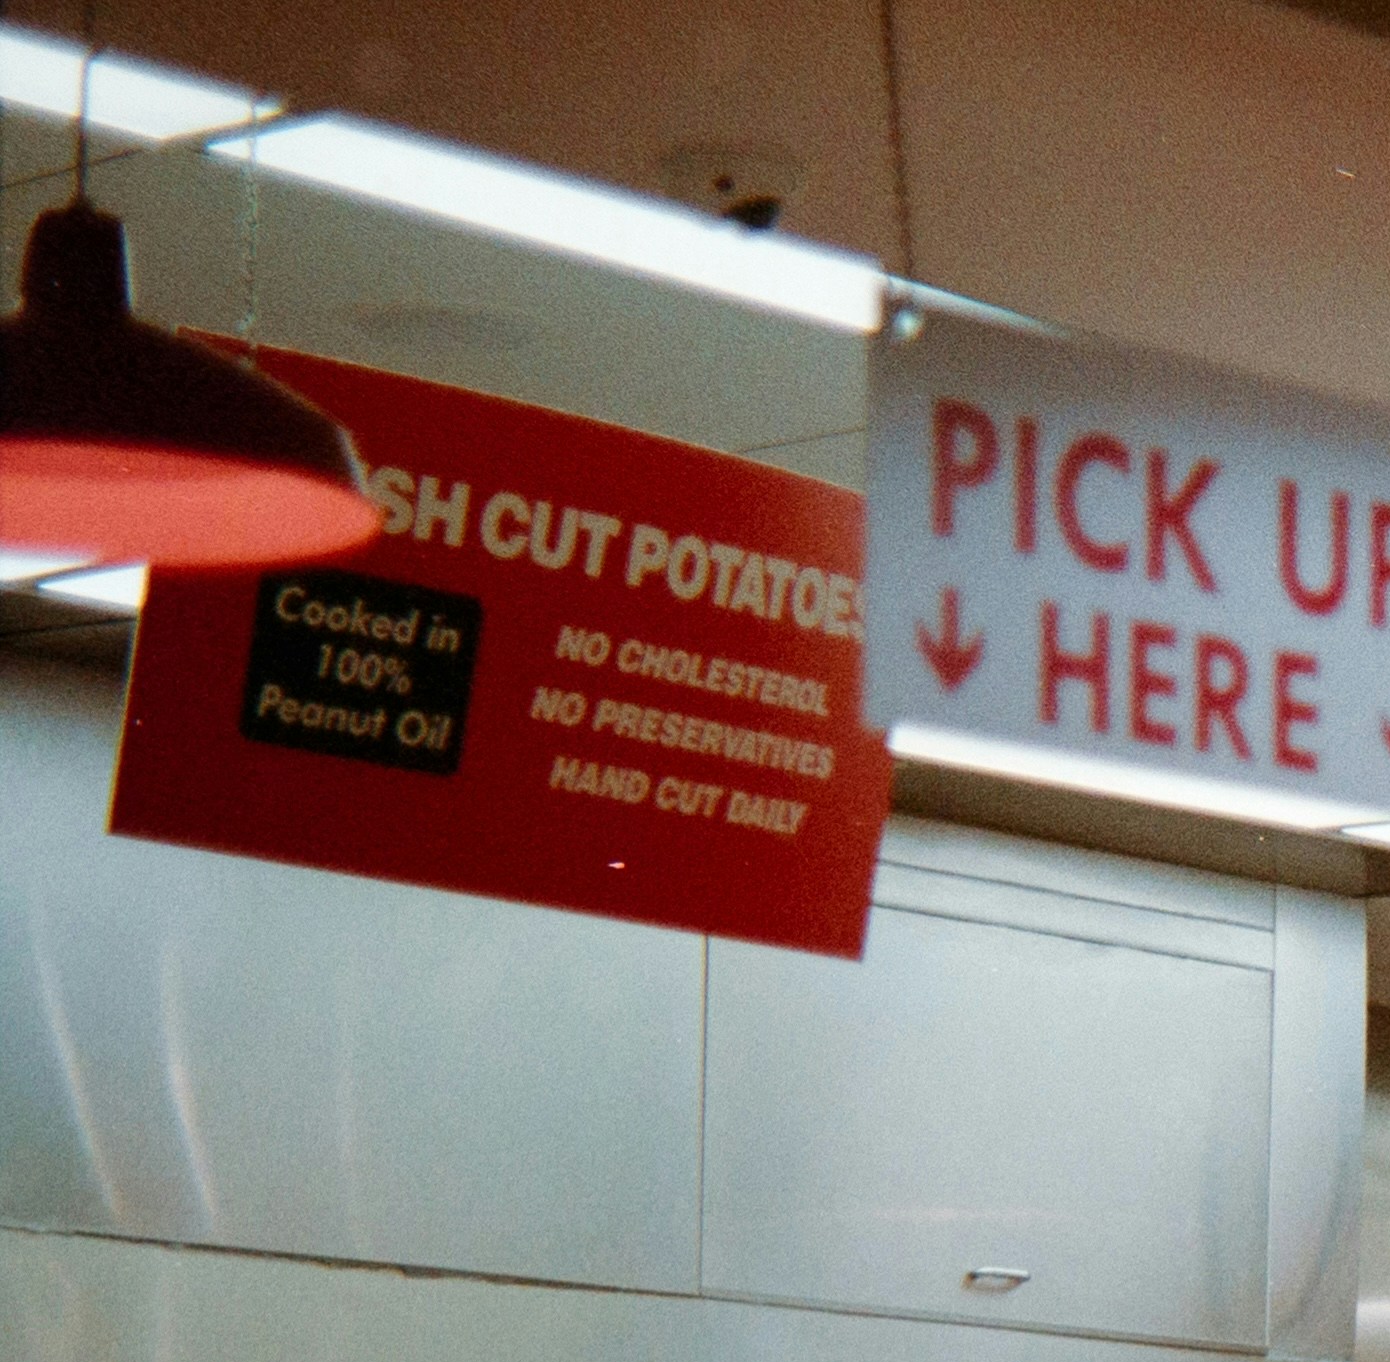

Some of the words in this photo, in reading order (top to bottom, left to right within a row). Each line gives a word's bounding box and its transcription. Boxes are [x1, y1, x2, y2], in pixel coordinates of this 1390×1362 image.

[369, 465, 471, 548] SH
[482, 491, 620, 578] CUT
[931, 396, 1222, 595] PICK
[275, 585, 417, 646] Cooked
[427, 611, 462, 654] in
[317, 643, 413, 696] 100%
[555, 626, 611, 667] NO
[616, 637, 830, 718] CHOLESTEROL
[1037, 599, 1319, 774] HERE
[256, 683, 387, 737] Peanut
[399, 709, 452, 751] Oil
[529, 686, 586, 728] NO
[592, 697, 836, 781] PRESERVATIVES
[548, 756, 651, 807] HAND
[655, 776, 721, 819] CUT
[726, 788, 811, 837] DAILY
